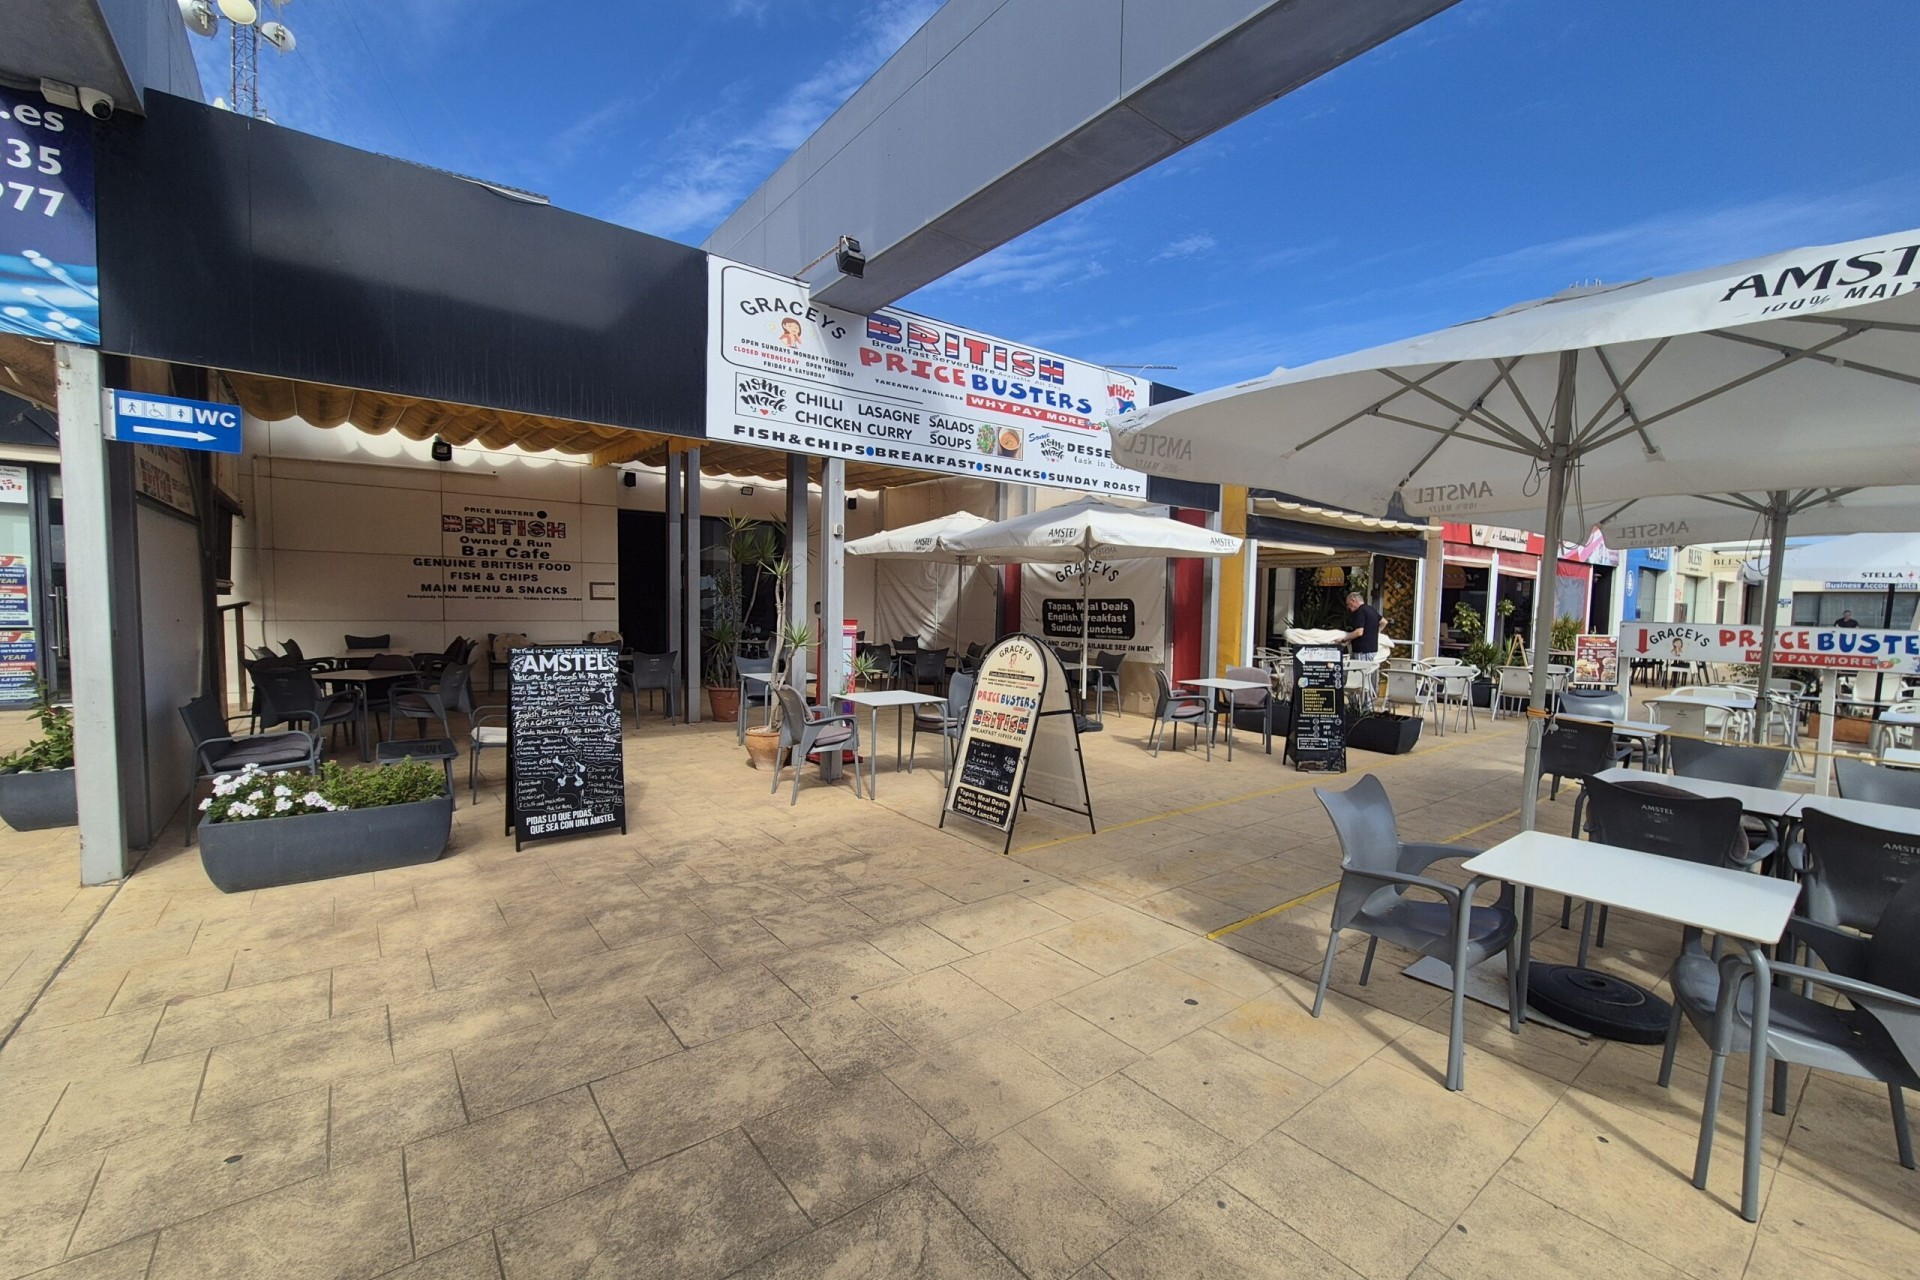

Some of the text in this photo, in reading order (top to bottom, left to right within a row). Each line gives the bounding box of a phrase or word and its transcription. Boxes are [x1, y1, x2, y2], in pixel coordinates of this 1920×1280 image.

[7, 138, 62, 175] 35
[0, 181, 64, 217] 77
[740, 298, 846, 340] GRACEYS
[741, 338, 847, 368] OPEN SUNDAYS MONDAY TUESDAY
[867, 312, 1064, 385] BRITISH
[733, 345, 854, 378] CLOSED WEDNESDAY OPEN THURSDAY
[763, 361, 786, 371] FRIDAY
[795, 368, 826, 379] SATURDAY
[872, 339, 930, 359] Breakfast
[932, 354, 969, 369] Served
[971, 362, 995, 375] Here
[998, 371, 1031, 383] Available
[859, 347, 1092, 414] PRICE BUSTERS
[875, 378, 963, 401] TAKEAWAY AVAILABLE
[195, 408, 236, 428] WC
[795, 391, 975, 434] CHILLI LASAGNE SALADS
[970, 397, 1086, 426] WHY PAY MORE
[795, 411, 971, 450] CHICKEN CURRY SOUPS
[1067, 443, 1112, 459] DESSE
[875, 448, 976, 469] BREAKFAST
[984, 464, 1040, 479] SNACKS
[1048, 473, 1098, 486] SUNDAY
[1103, 481, 1141, 492] ROAST
[495, 509, 534, 517] BUSTERS
[442, 514, 566, 539] BRITISH
[459, 536, 507, 546] Owned
[527, 539, 552, 548] Run
[462, 545, 550, 560] Bar Cafe
[413, 558, 571, 572] GENUINE BRITISH FOOD
[450, 571, 538, 582] FISH & CHIPS
[421, 584, 567, 595] MAIN MENU & SNACKS
[1047, 601, 1128, 614] Tapas, Mal Deals
[1047, 613, 1078, 623] English
[1051, 623, 1123, 634] Sunday unches
[1649, 627, 1710, 647] GRACEYS
[999, 644, 1033, 661] GRACEYS
[1079, 642, 1113, 650] AAILABLE
[521, 654, 610, 673] AMSTEL
[1749, 652, 1871, 666] WY PAY MORE
[513, 673, 541, 681] Welcome
[977, 690, 1036, 709] PRICE BUSTERS
[515, 711, 539, 720] English
[541, 707, 572, 717] Breakfast
[972, 708, 1030, 735] BRITISH
[515, 720, 530, 729] Fish
[970, 726, 997, 736] BREAKFAST
[957, 795, 1005, 816] English Breakfast
[959, 788, 1007, 809] Tapas, Meal Deals
[526, 815, 547, 826] PIDAS
[547, 813, 557, 822] LO
[557, 812, 571, 821] QUE
[957, 803, 1000, 823] Sunday Lunches
[1641, 804, 1675, 816] AMSTEL
[530, 825, 545, 835] QUE
[545, 823, 559, 832] SEA
[560, 821, 574, 830] CON
[575, 818, 589, 828] UNA
